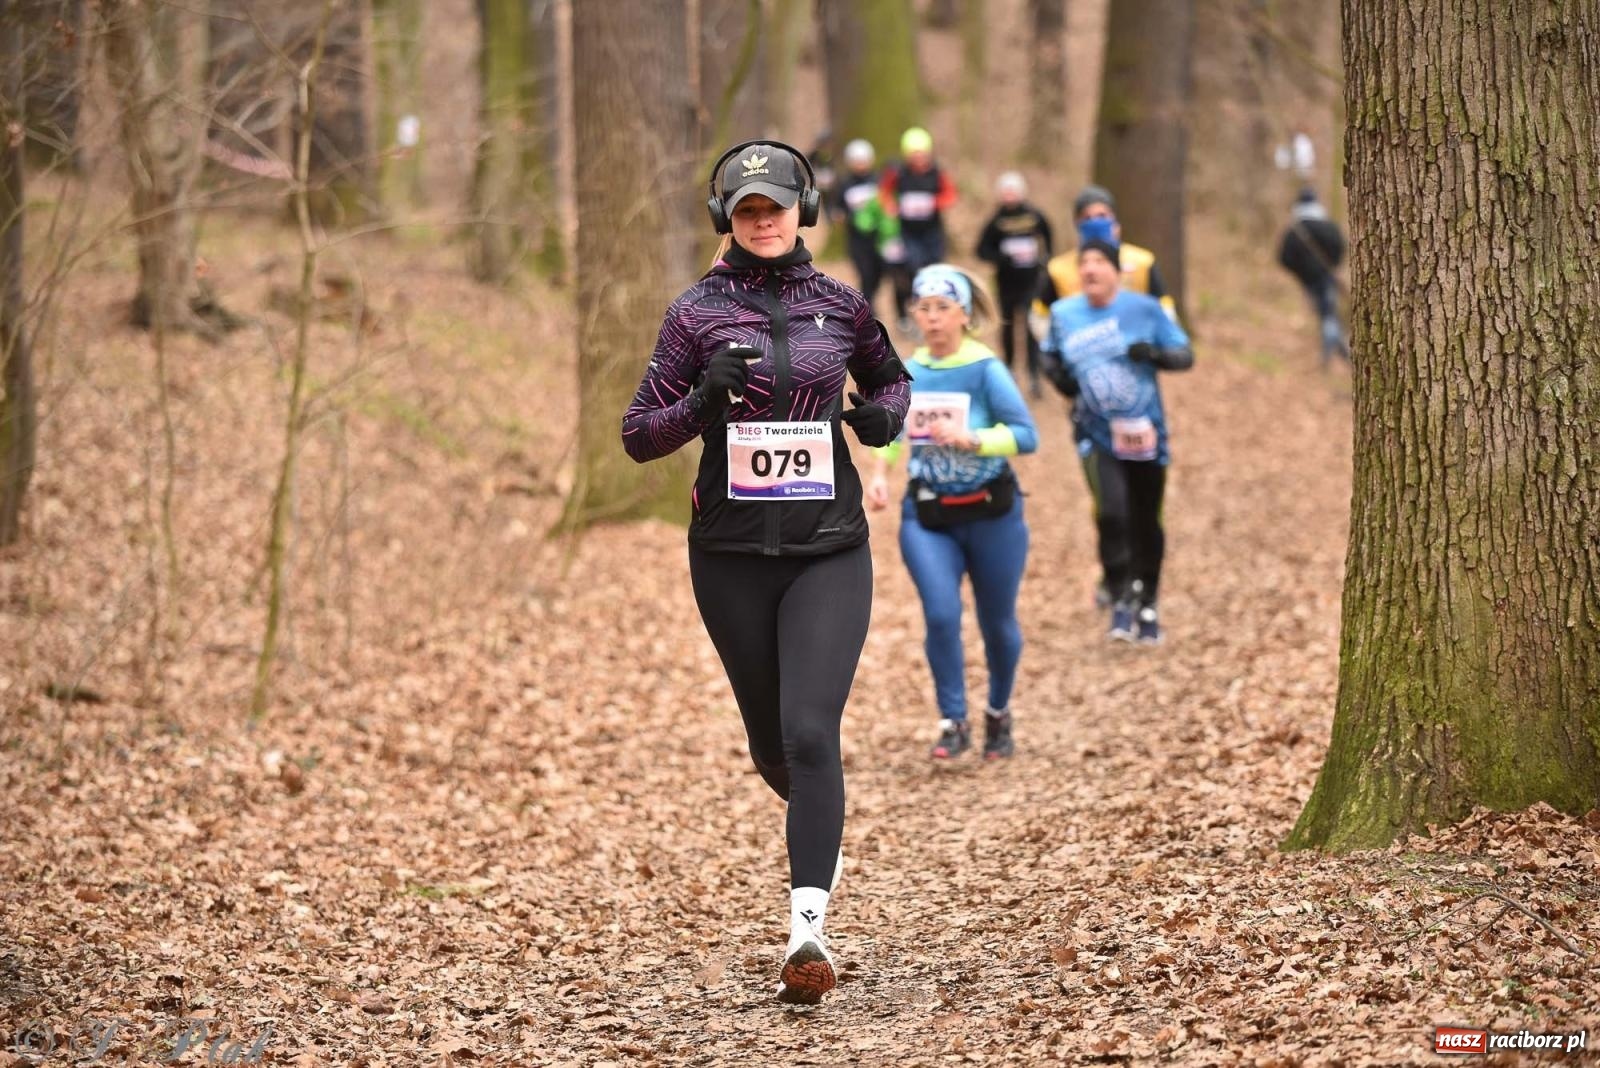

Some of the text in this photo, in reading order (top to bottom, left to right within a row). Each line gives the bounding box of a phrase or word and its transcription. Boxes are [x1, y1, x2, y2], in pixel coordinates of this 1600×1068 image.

[742, 167, 769, 177] adidas
[737, 425, 823, 435] BIEG Twardziela
[751, 449, 811, 477] 079
